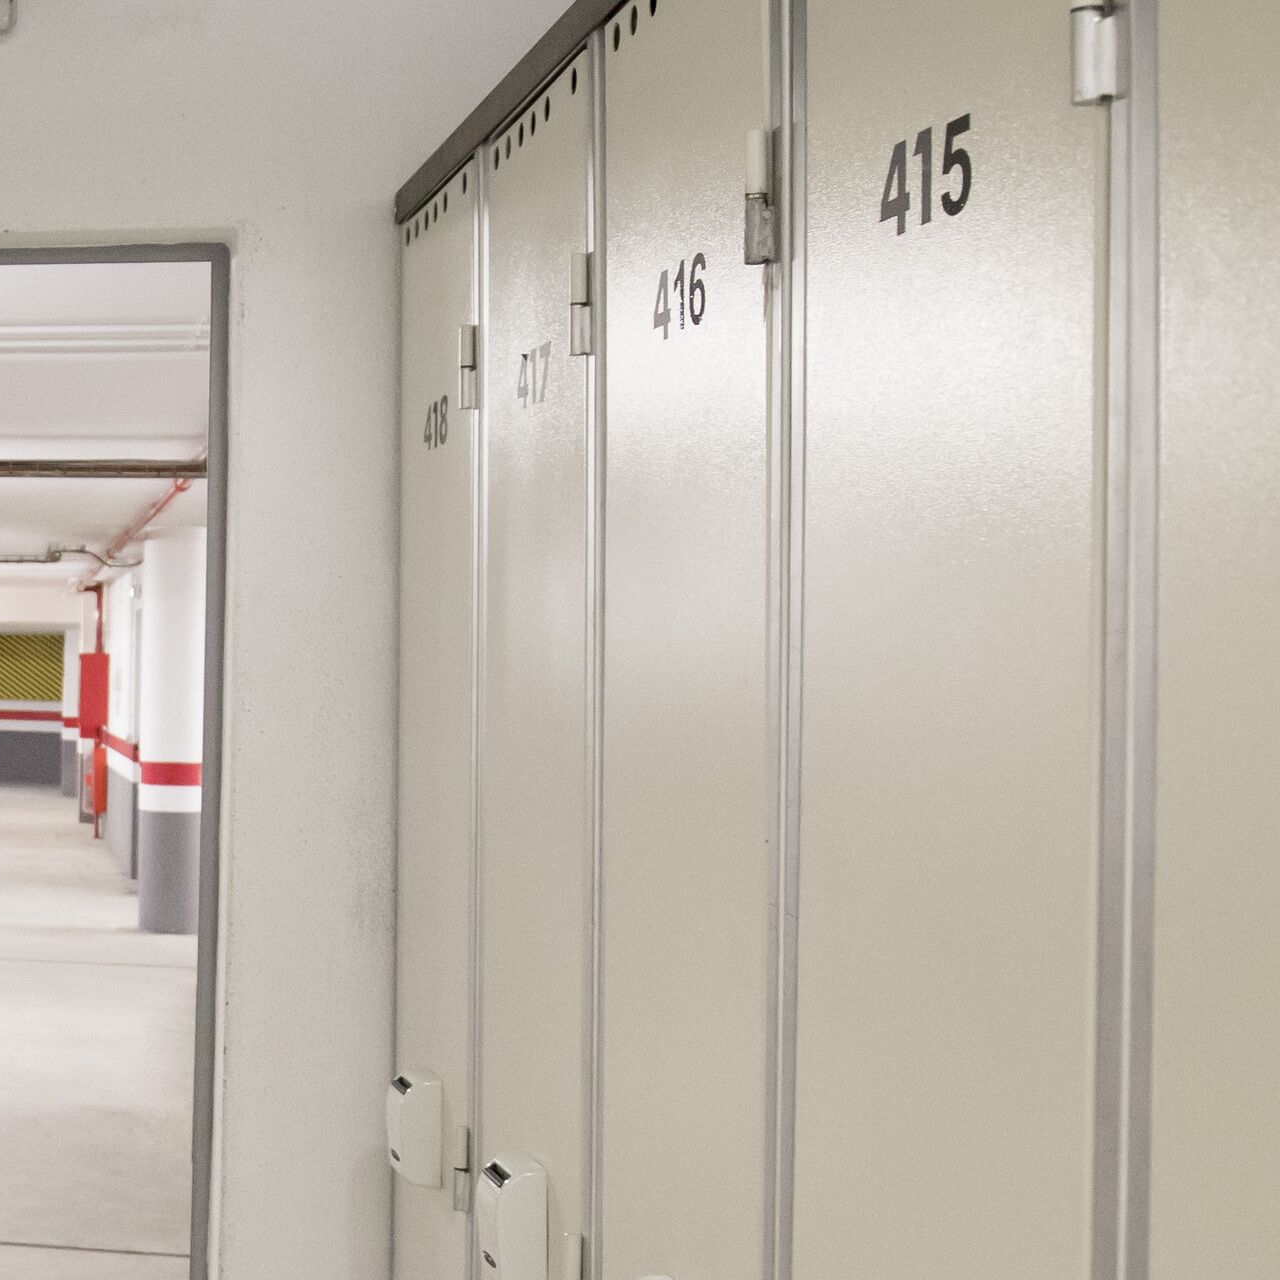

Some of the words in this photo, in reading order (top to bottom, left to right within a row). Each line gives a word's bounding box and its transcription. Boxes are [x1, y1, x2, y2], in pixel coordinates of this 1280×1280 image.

[879, 112, 973, 236] 415
[653, 252, 706, 340] 416
[517, 341, 552, 408] 417
[423, 394, 448, 450] 418
